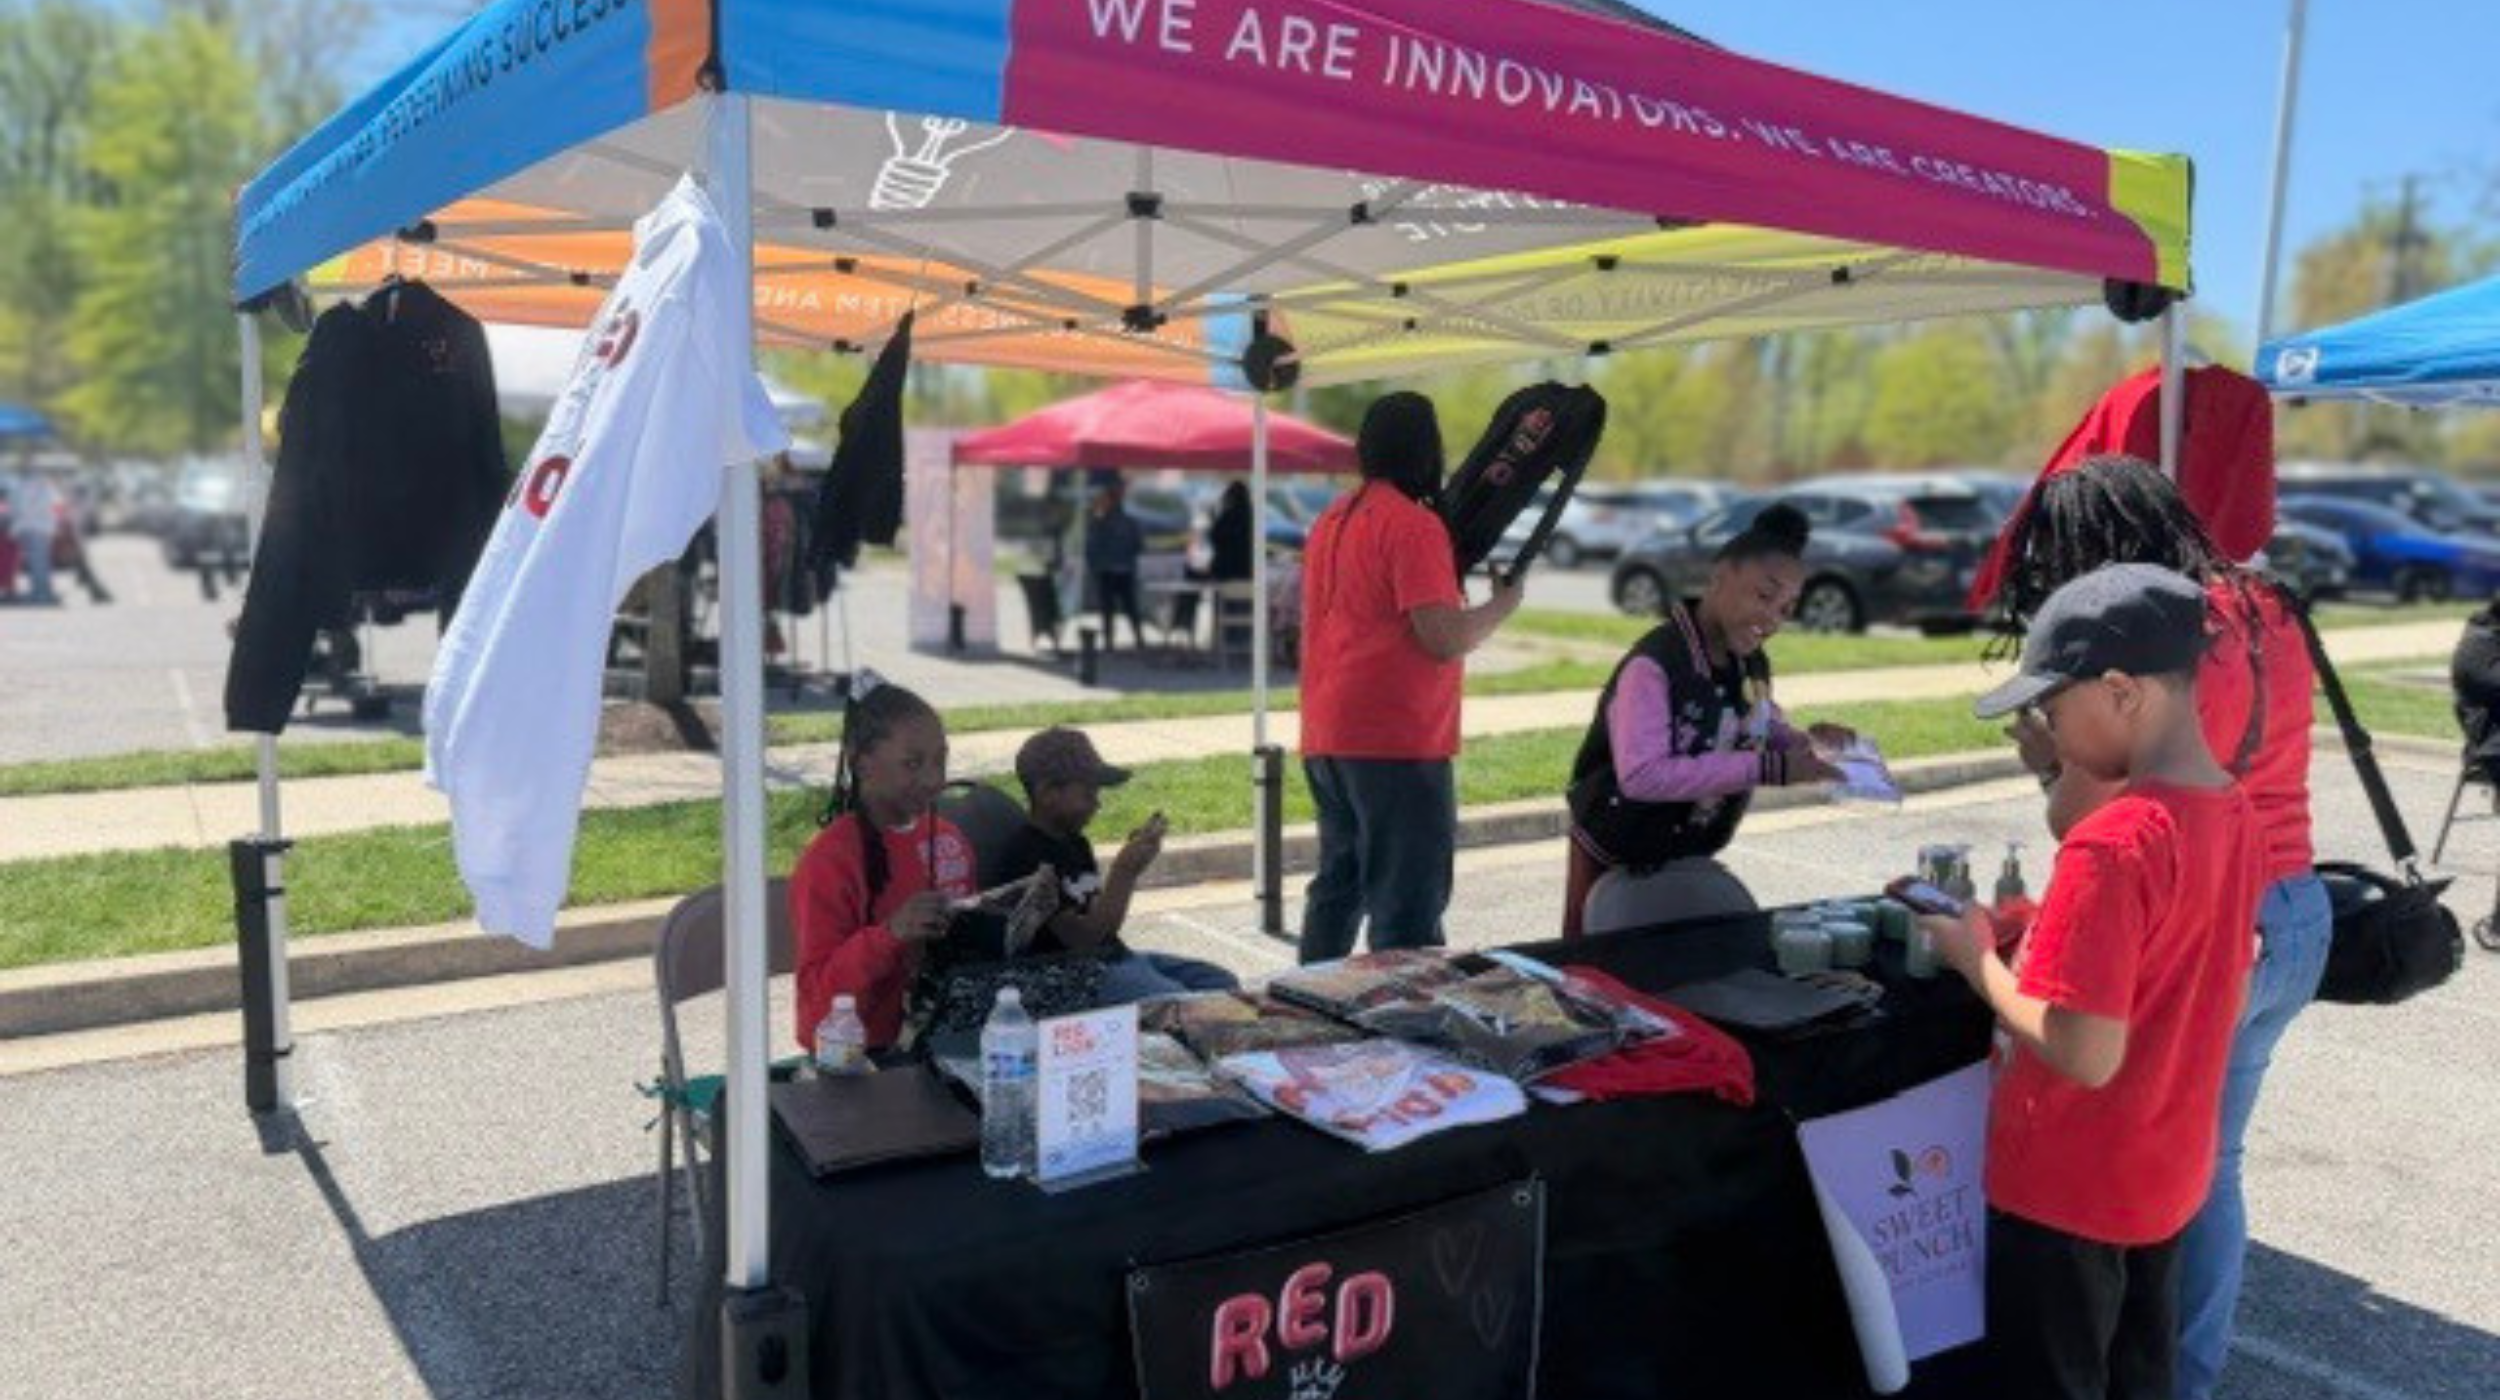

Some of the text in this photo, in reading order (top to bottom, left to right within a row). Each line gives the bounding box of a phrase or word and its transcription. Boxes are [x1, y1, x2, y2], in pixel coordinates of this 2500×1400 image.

[1088, 0, 1193, 53] WE
[1224, 9, 1361, 81] ARE
[1872, 1183, 1970, 1249] SWEET
[1210, 1261, 1395, 1390] RED
